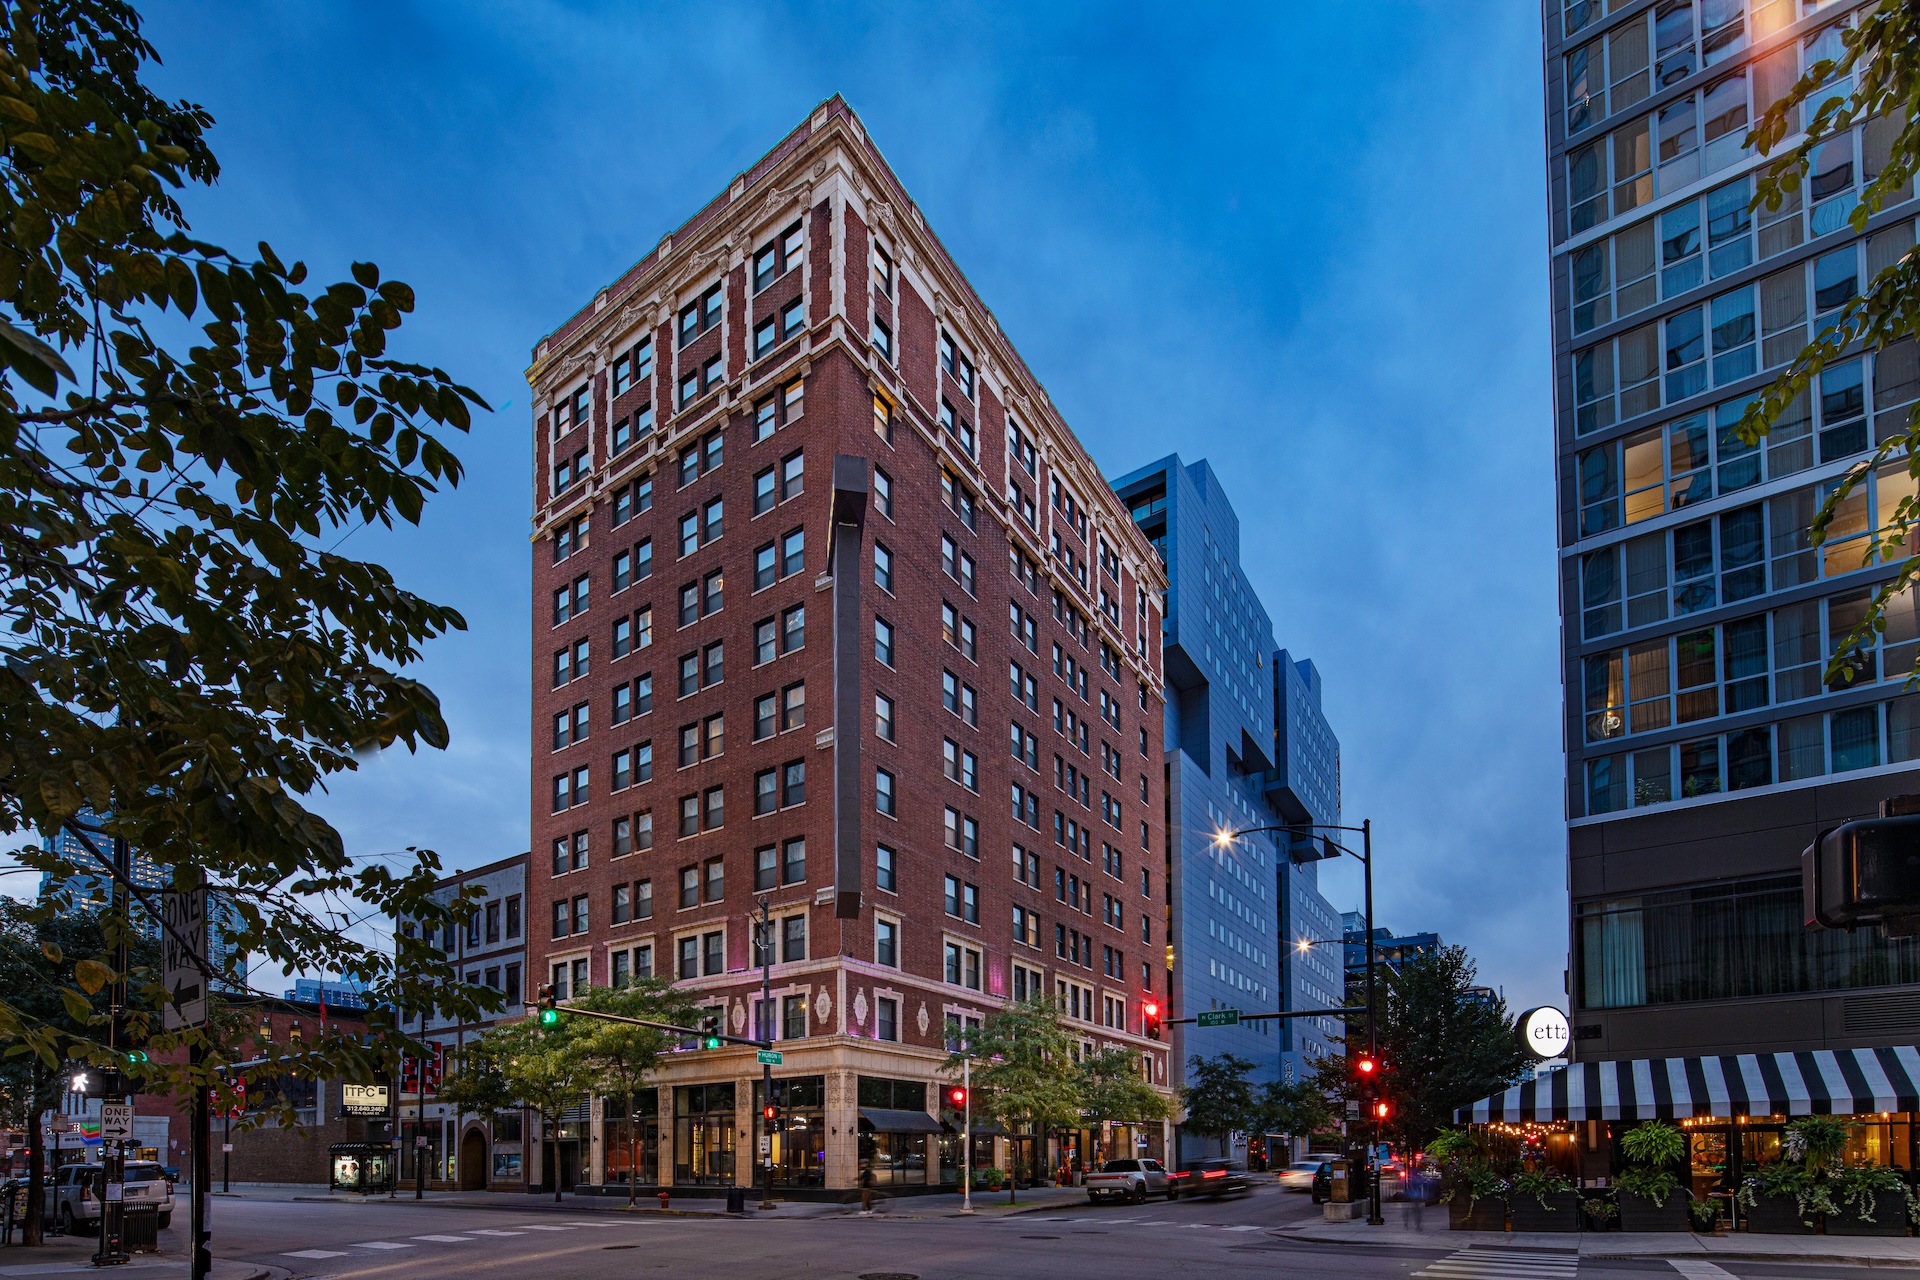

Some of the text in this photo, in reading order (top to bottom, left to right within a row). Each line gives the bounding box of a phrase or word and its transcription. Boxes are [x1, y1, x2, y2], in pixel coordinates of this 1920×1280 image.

[168, 890, 199, 927] ONE
[167, 927, 200, 972] WAY
[1534, 1023, 1567, 1040] etta
[345, 1086, 375, 1098] ITPC
[105, 1107, 129, 1116] ONE
[104, 1117, 129, 1125] WAY
